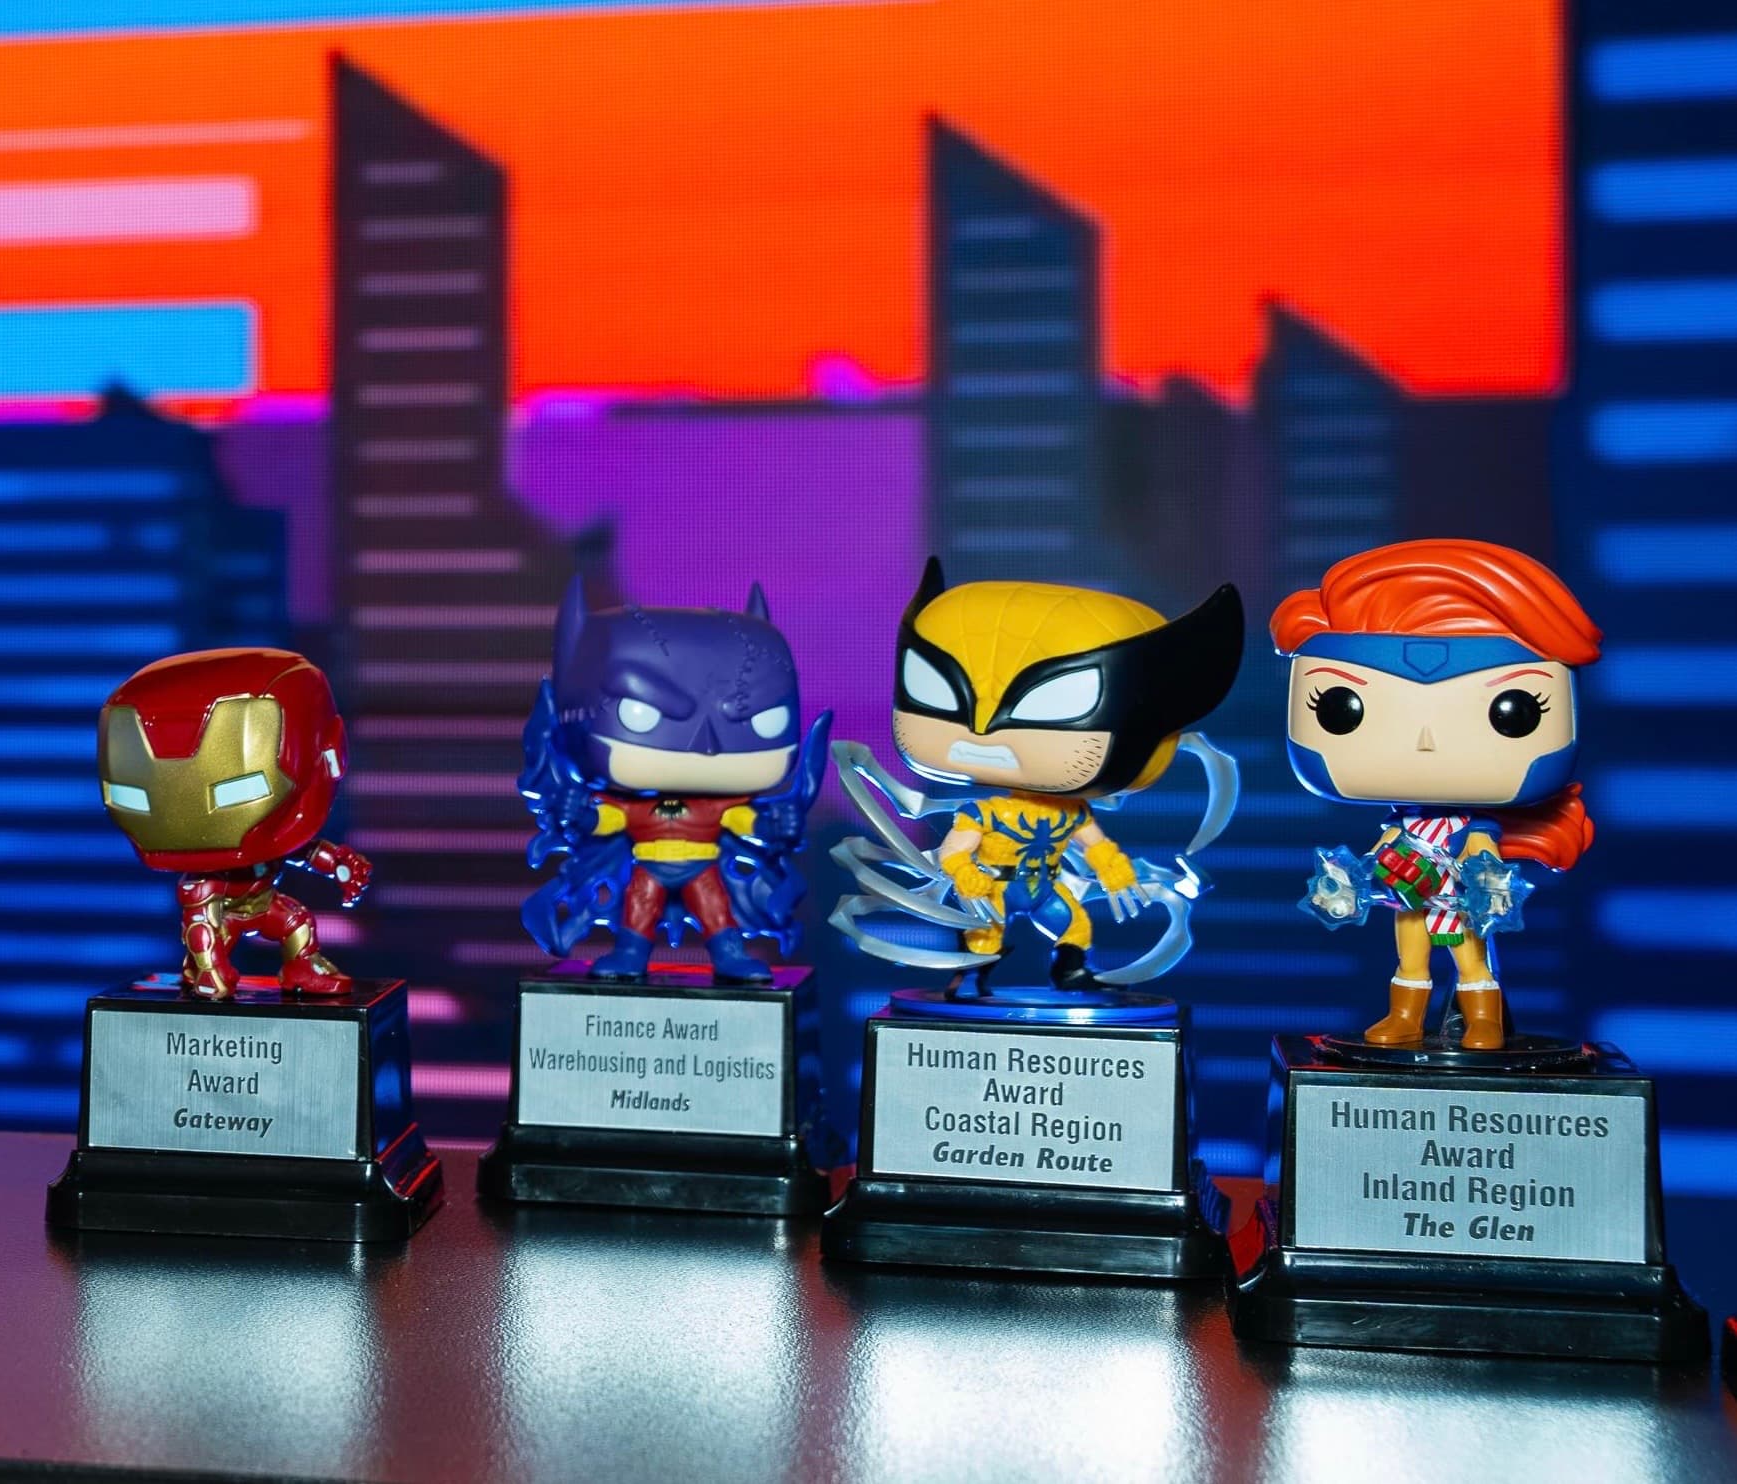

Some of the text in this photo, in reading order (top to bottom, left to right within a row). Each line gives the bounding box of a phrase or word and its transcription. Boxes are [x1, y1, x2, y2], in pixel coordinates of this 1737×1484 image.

[584, 1014, 719, 1042] Finance Award
[166, 1031, 283, 1065] Marketing
[907, 1041, 1145, 1080] Human Resources
[528, 1047, 776, 1083] Warehousing and Logistics
[187, 1068, 260, 1095] Award
[982, 1077, 1064, 1107] Award
[610, 1089, 691, 1112] Midlands
[173, 1107, 274, 1138] Gateway
[924, 1105, 1122, 1145] Coastal Region
[1331, 1100, 1610, 1139] Human Resources
[932, 1140, 1113, 1173] Garden Route
[1420, 1139, 1515, 1170] Award
[1362, 1172, 1575, 1212] Inland Region
[1403, 1211, 1535, 1242] The Glen
